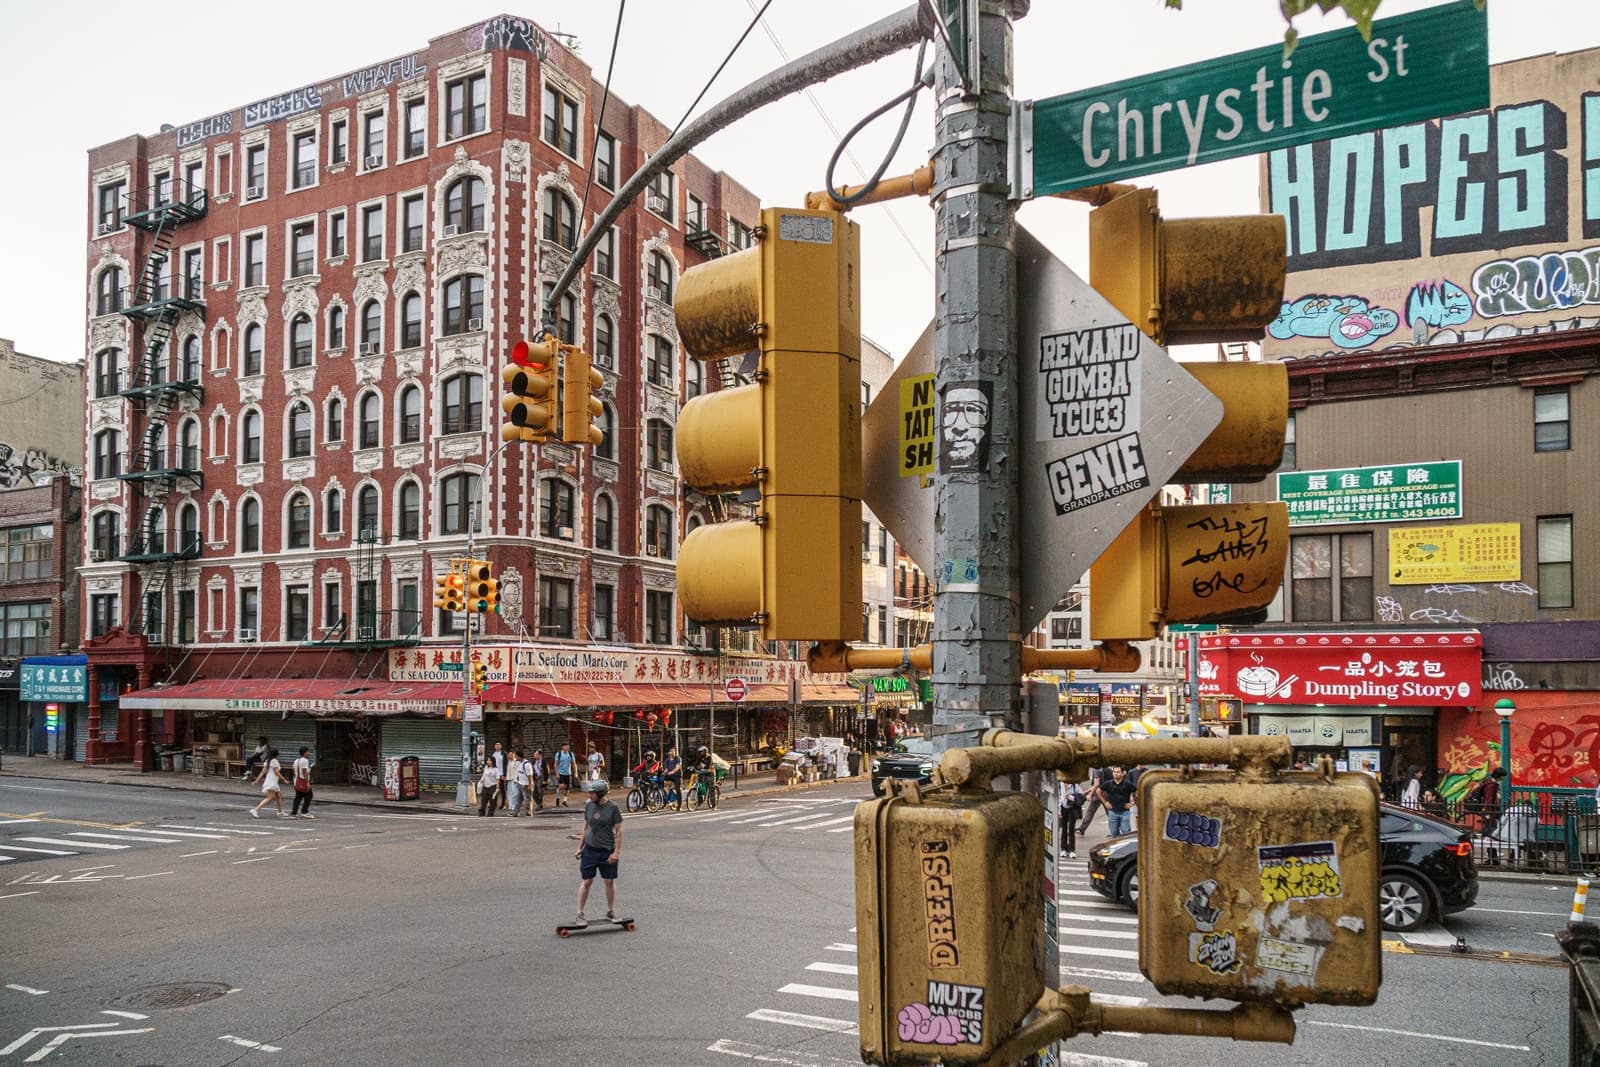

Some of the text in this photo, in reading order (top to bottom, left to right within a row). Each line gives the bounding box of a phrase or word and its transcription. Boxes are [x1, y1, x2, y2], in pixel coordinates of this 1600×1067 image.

[1082, 35, 1409, 166] Chrystie St
[1268, 101, 1560, 266] HOPES
[1040, 323, 1140, 372] REMAND
[1046, 360, 1131, 405] GUMBA
[1051, 397, 1125, 438] TCU33
[1048, 432, 1147, 506] GENIE
[1307, 468, 1430, 490] 最佳保險
[1063, 479, 1142, 513] GRANDPA GANG
[1282, 491, 1302, 499] BEST
[1303, 489, 1344, 498] COVERAGE
[1345, 486, 1388, 495] INSURANCE
[1389, 484, 1438, 493] BROKERAGE
[1402, 508, 1456, 518] 343-9406
[539, 651, 578, 667] Seafood
[1318, 660, 1446, 678] 一品小笼包
[408, 671, 449, 680] SEAFOOD
[892, 676, 907, 692] SON
[1304, 681, 1457, 700] Dumpling Story
[1115, 697, 1135, 705] YORK
[928, 982, 984, 1010] MUTZ
[947, 1007, 982, 1020] MOBB
